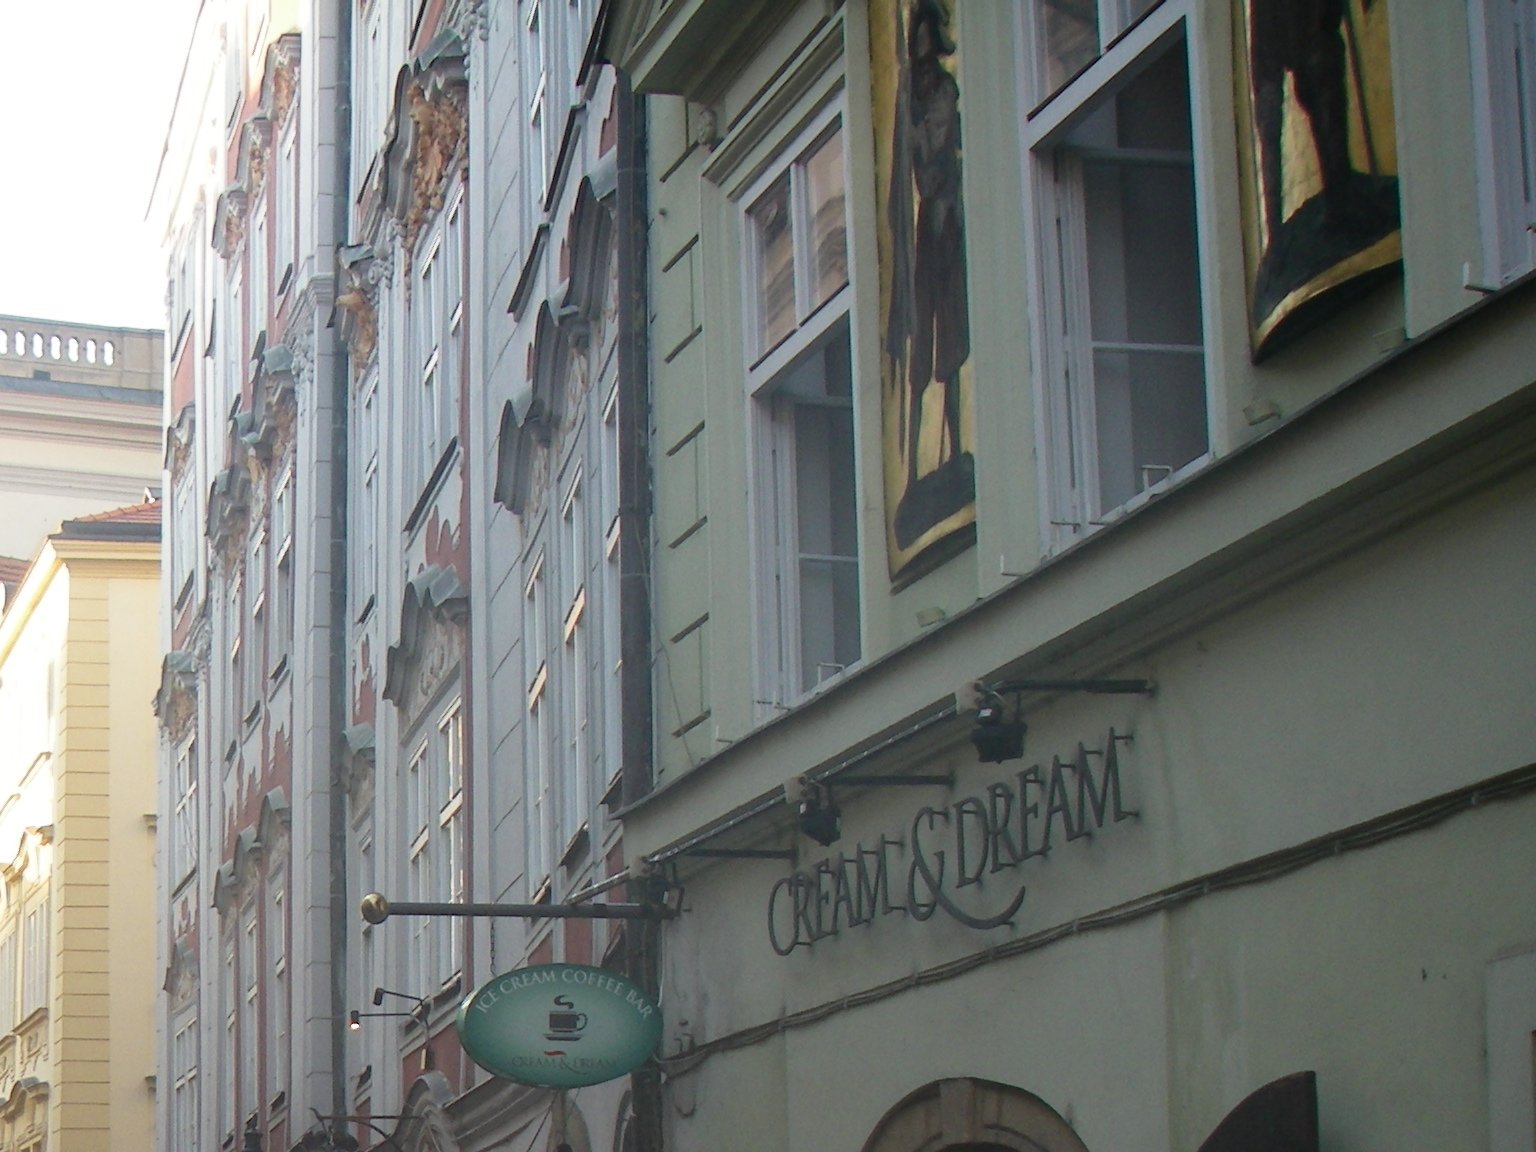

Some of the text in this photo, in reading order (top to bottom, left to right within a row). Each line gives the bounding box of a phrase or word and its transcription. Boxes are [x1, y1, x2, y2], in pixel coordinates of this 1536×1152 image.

[768, 833, 893, 956] CREAM
[954, 727, 1128, 888] DREAM
[475, 968, 654, 1019] ICE CREAM COFFEE BAR
[511, 1057, 556, 1067] CREAM
[573, 1056, 617, 1067] DREAM
